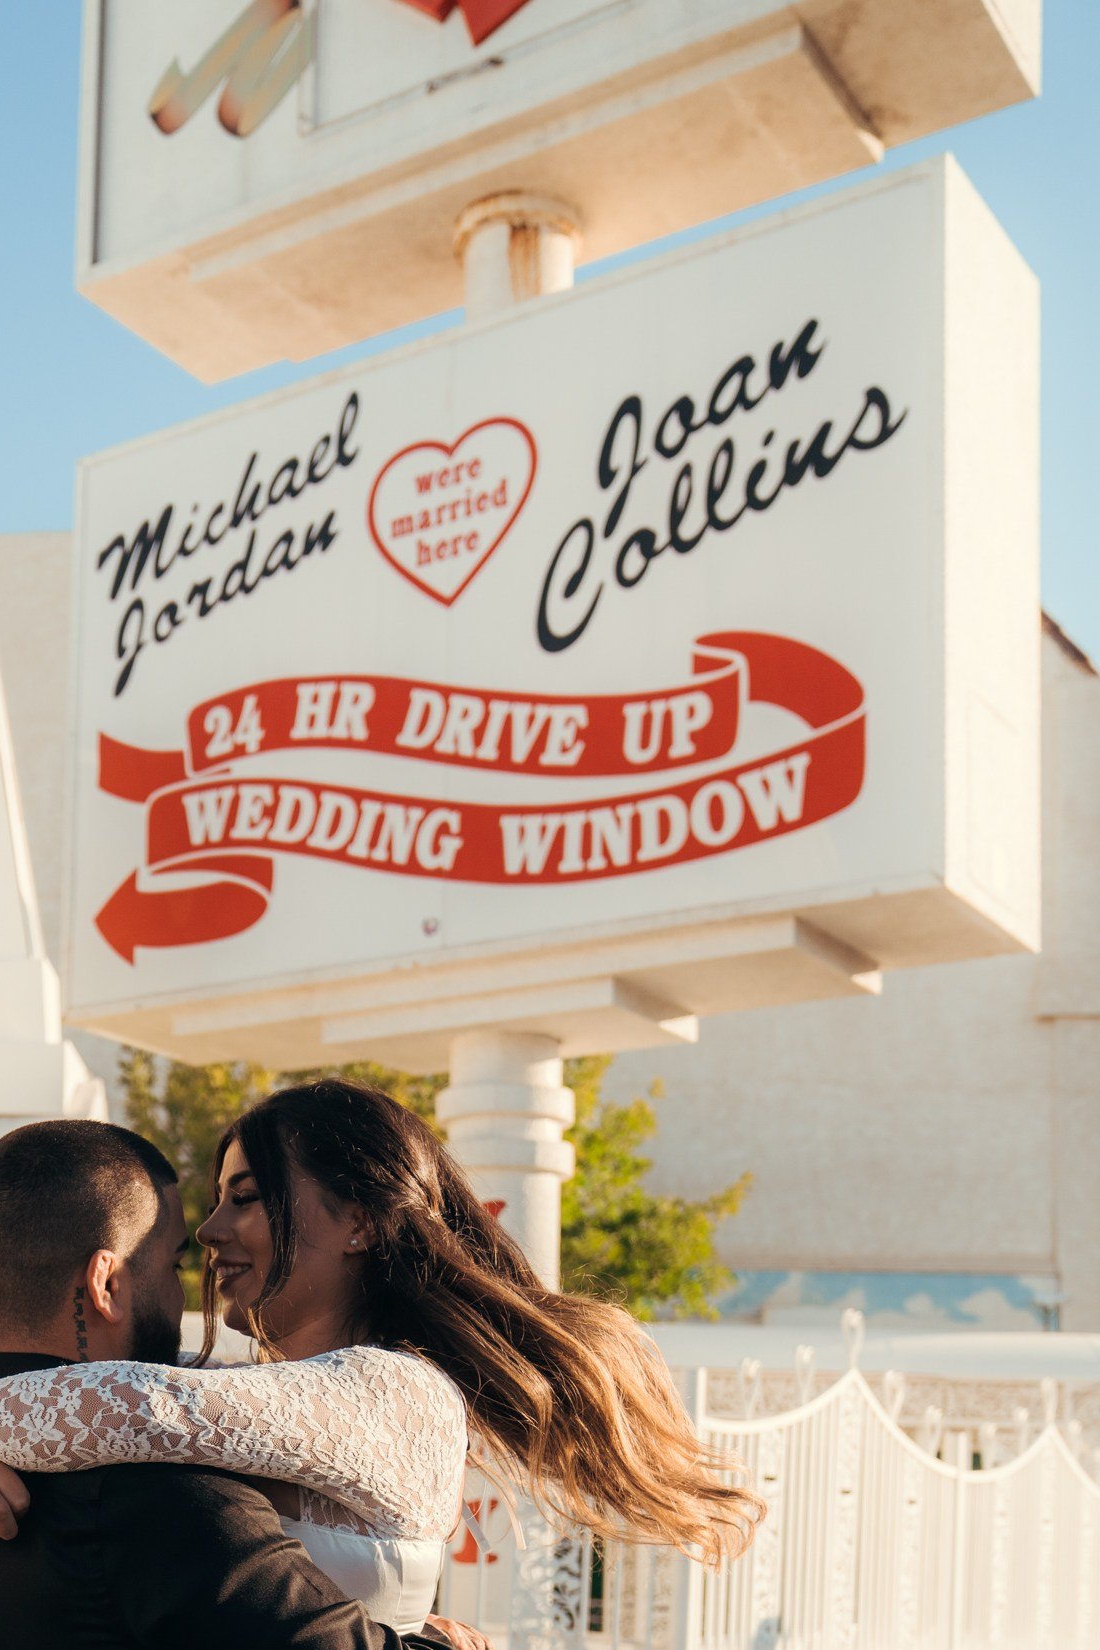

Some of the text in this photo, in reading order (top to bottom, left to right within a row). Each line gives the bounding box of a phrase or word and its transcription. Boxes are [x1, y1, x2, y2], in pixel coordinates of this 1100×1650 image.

[415, 457, 481, 495] were
[596, 320, 825, 539] Joan
[97, 392, 359, 600] Michael
[391, 479, 508, 539] married
[416, 531, 479, 567] here
[536, 385, 908, 654] Collins
[114, 511, 337, 697] Jordan
[203, 681, 713, 767] 24 HR DRIVE UP
[181, 751, 811, 875] WEDDING WINDOW
